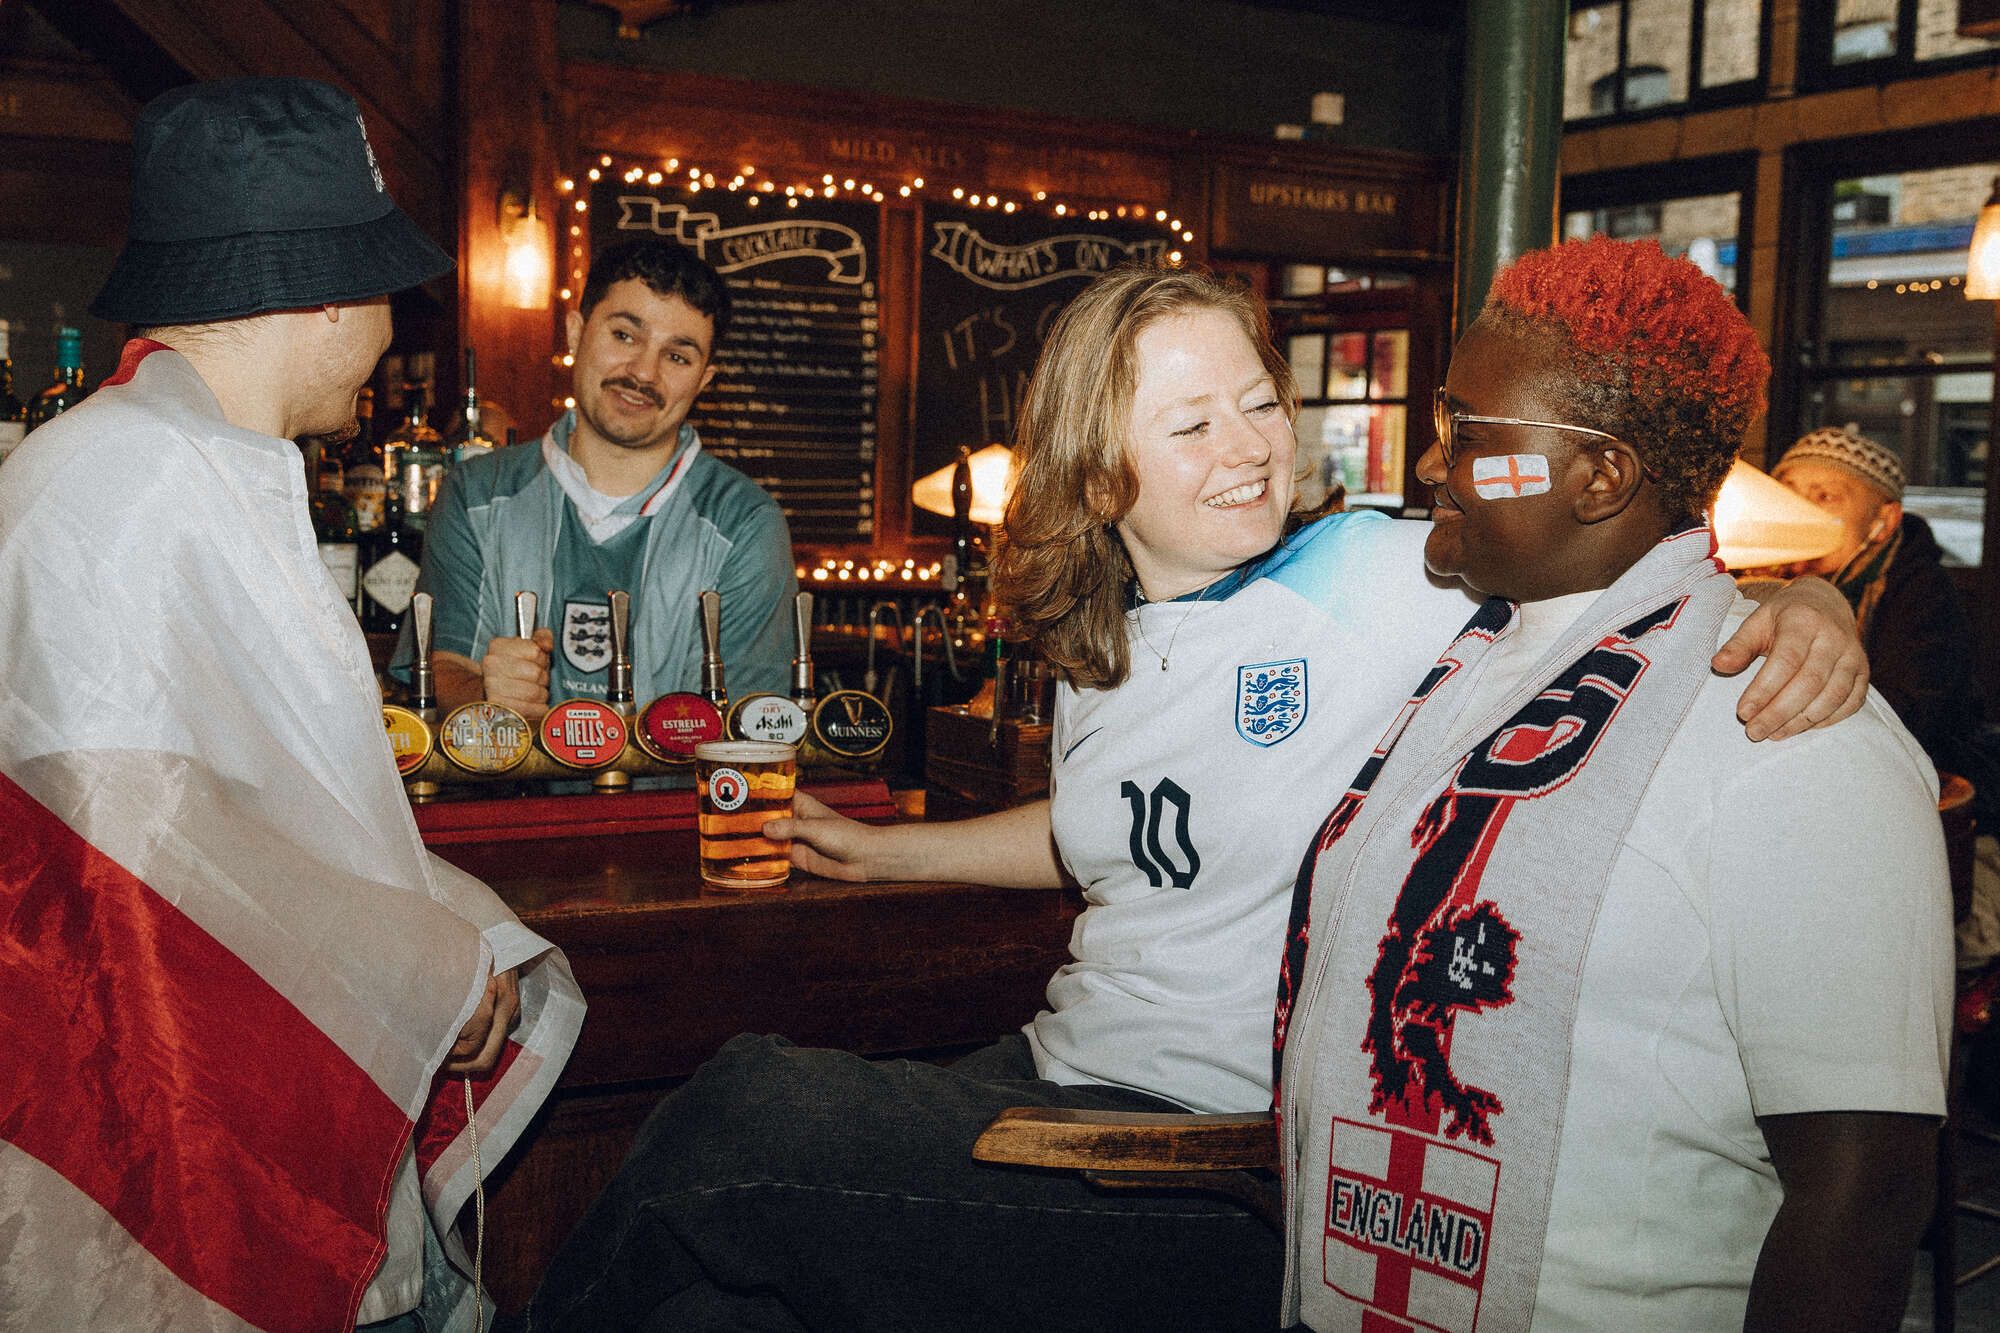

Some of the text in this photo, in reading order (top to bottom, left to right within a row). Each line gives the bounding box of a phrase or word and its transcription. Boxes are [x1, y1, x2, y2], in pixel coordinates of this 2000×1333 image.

[1249, 184, 1396, 215] UPSTAIRS BAR
[722, 228, 819, 265] COCKTAILS
[1074, 240, 1109, 272] ON
[564, 719, 606, 747] HELLS
[662, 718, 707, 729] ESTRELLA
[756, 714, 793, 730] Asahi
[827, 725, 883, 738] GUINNESS
[452, 726, 521, 748] NECK OIL
[1120, 776, 1201, 890] 10
[1328, 1176, 1485, 1276] ENGLAND
